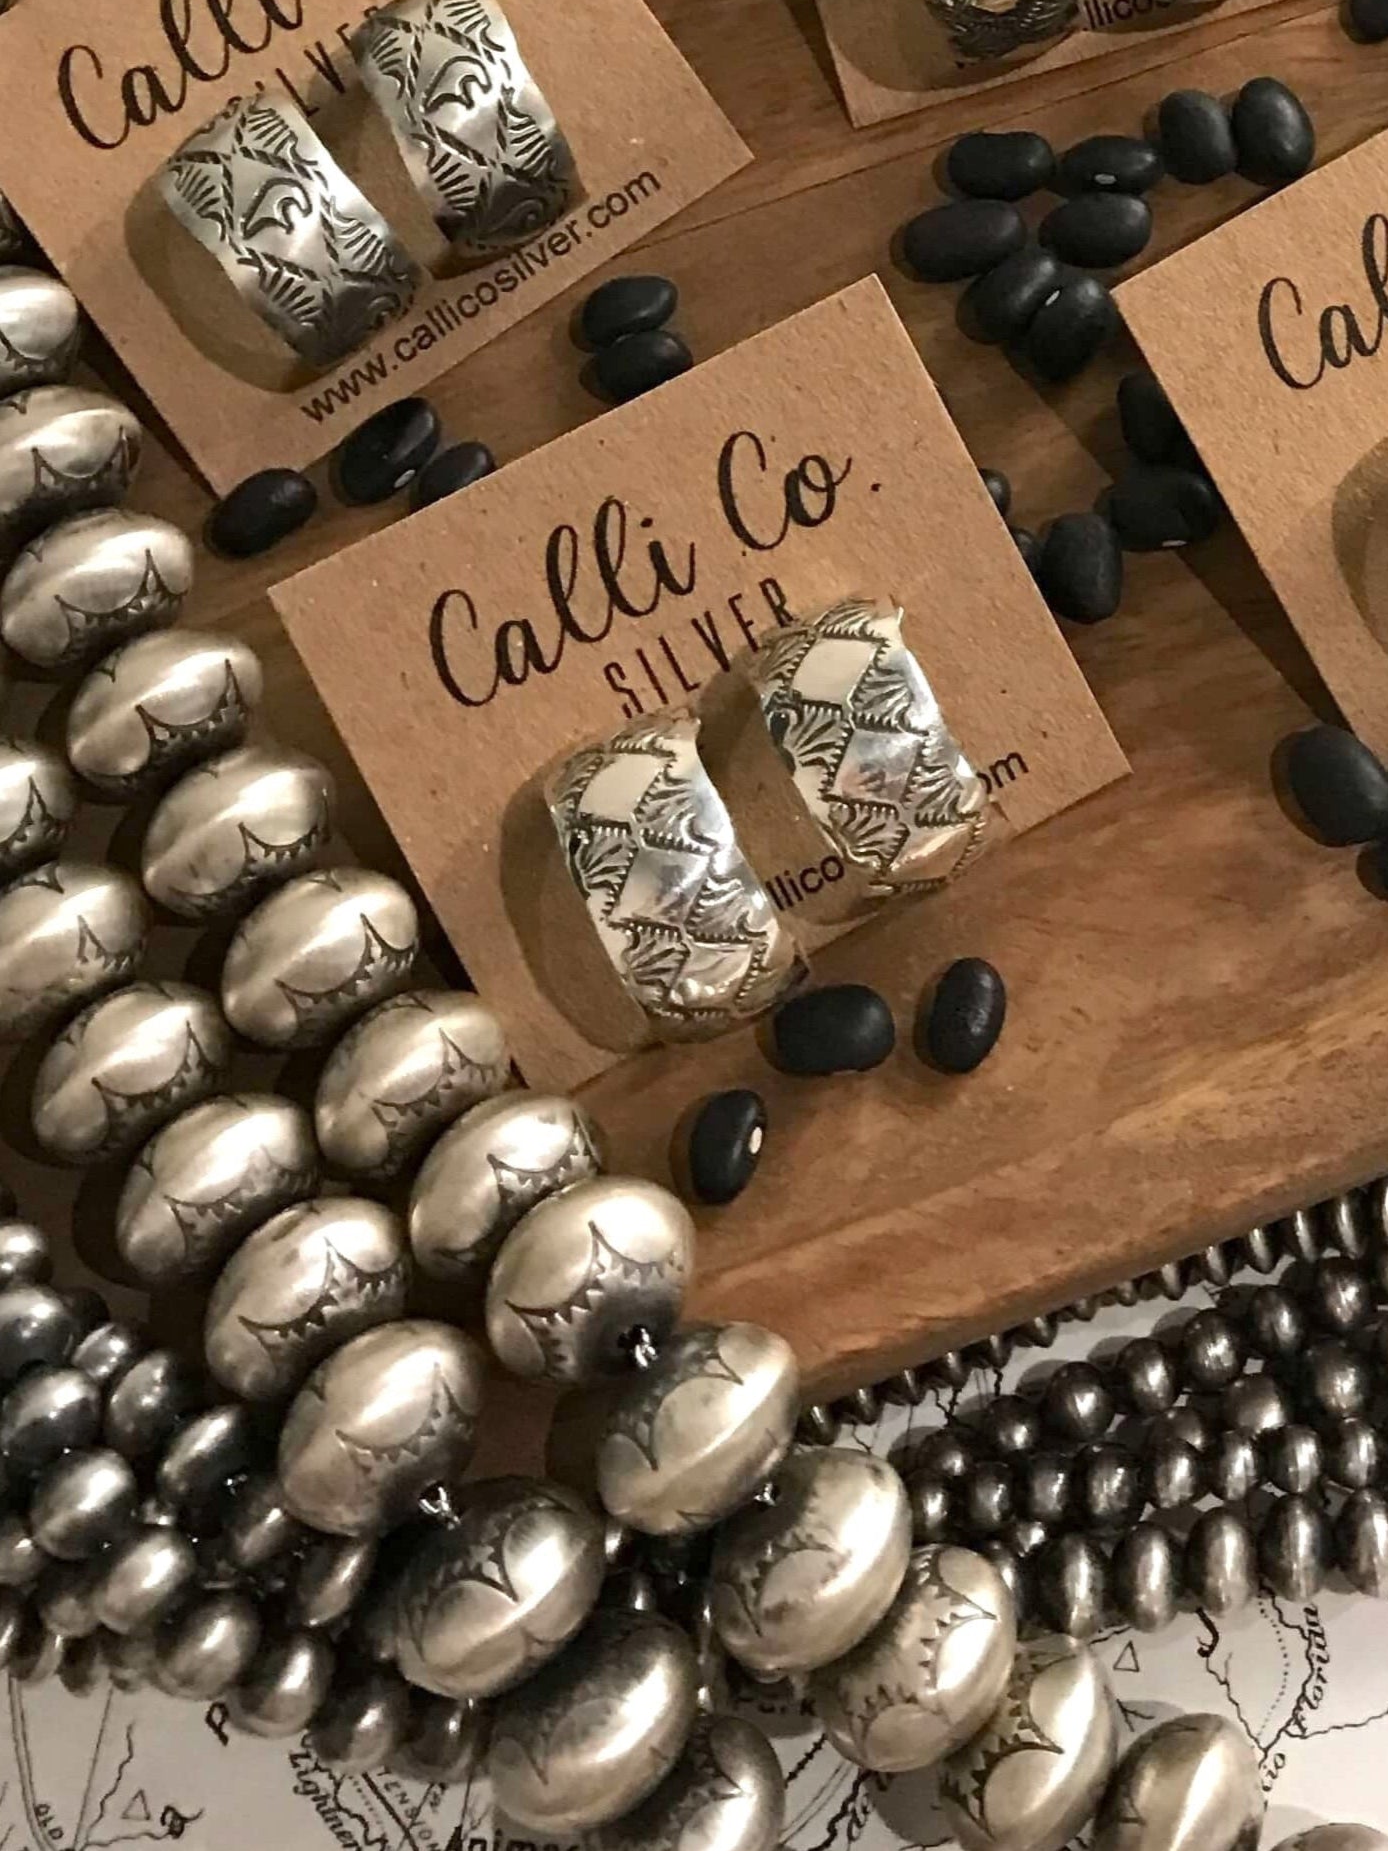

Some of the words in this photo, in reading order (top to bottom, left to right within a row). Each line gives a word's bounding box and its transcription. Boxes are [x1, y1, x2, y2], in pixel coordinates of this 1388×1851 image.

[301, 168, 661, 423] www.callicosilver.com
[428, 493, 697, 708] Calli
[716, 429, 882, 551] Co.
[603, 578, 797, 719] SILVER
